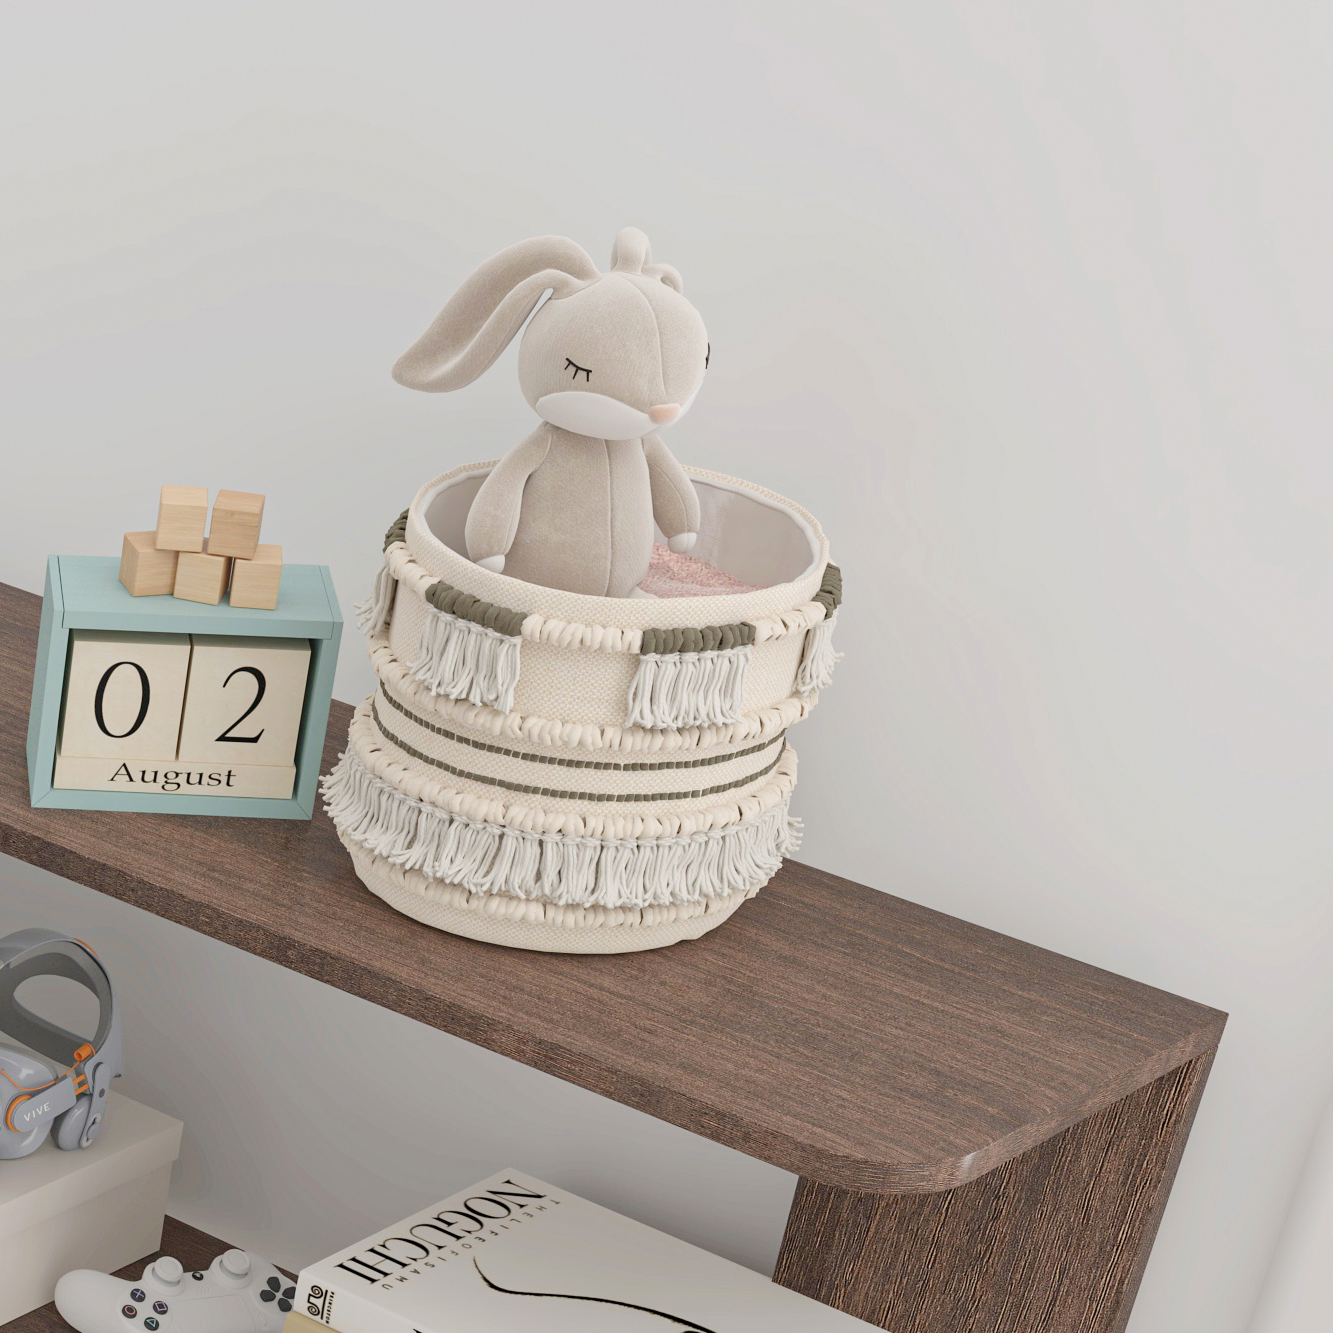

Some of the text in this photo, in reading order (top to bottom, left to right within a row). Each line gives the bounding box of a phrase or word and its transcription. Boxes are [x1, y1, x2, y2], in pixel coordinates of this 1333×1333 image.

[94, 661, 266, 743] 0 2
[107, 763, 236, 791] August
[23, 1102, 51, 1122] VIVE
[334, 1179, 548, 1286] NOGUCHI
